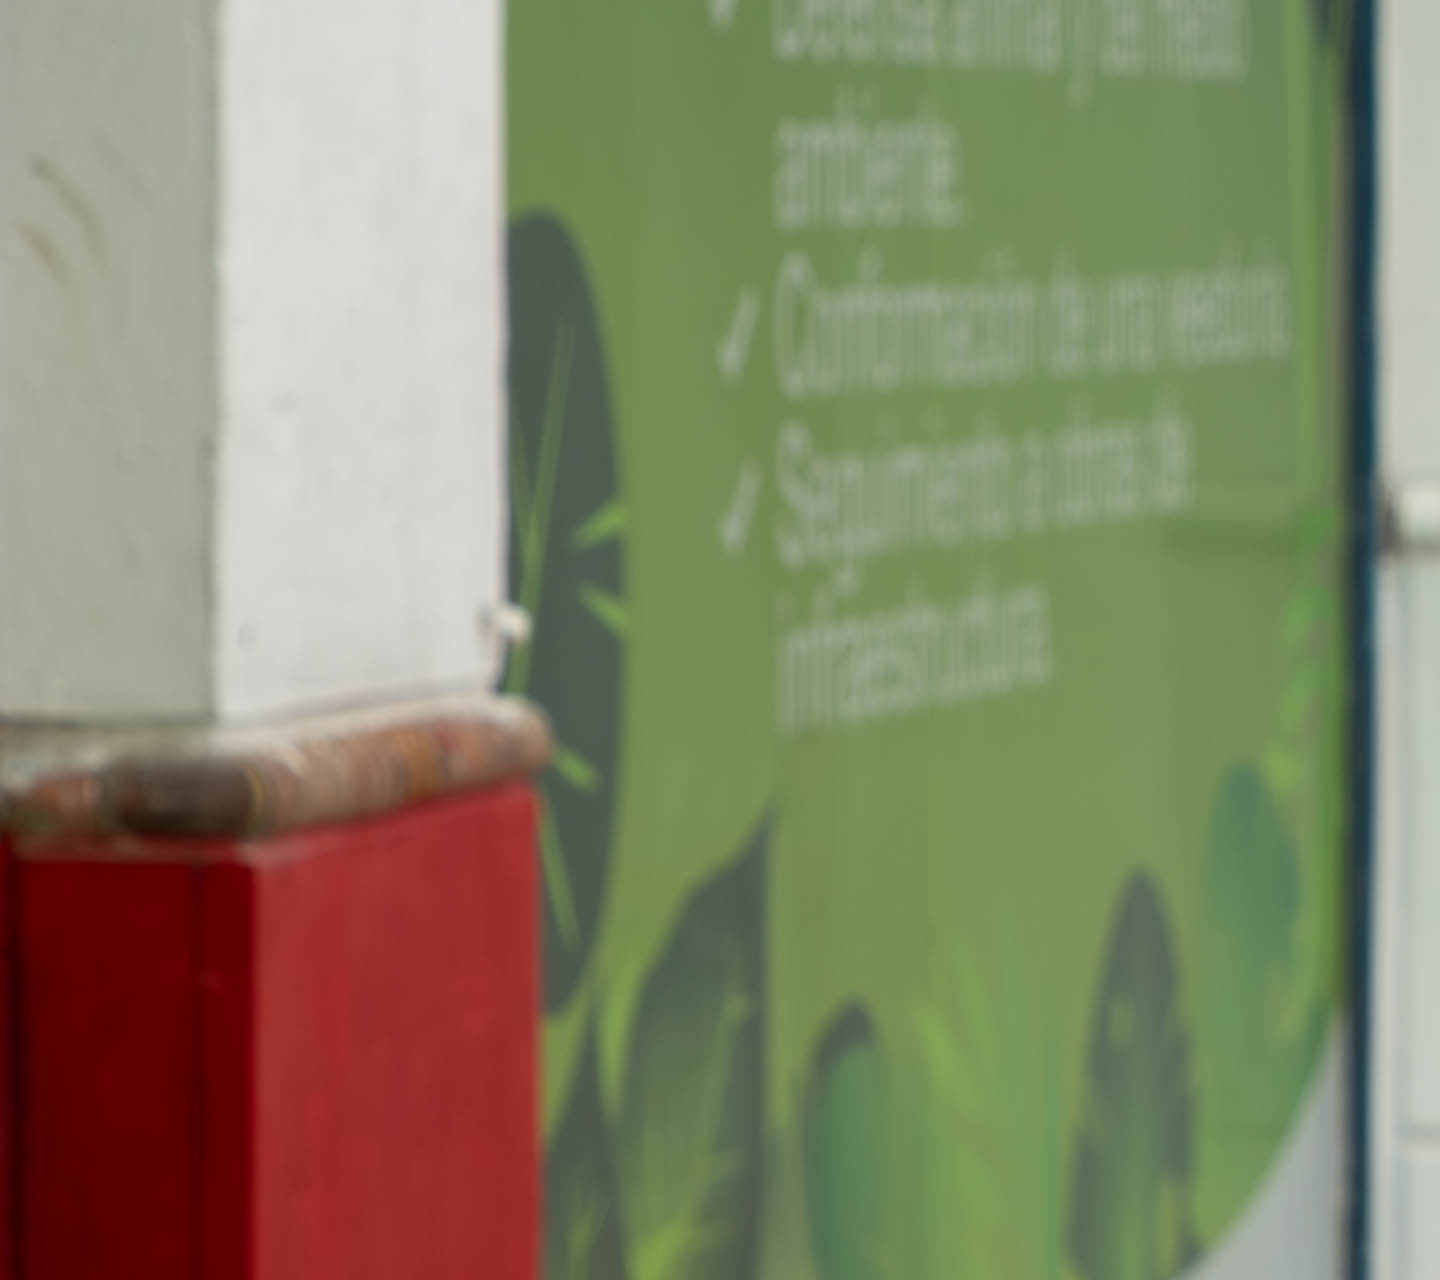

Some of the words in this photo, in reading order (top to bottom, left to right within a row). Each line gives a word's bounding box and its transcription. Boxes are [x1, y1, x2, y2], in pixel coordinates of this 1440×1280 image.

[774, 247, 1036, 401] Conformación
[1050, 242, 1092, 377] de
[775, 417, 1012, 601] Seguimiento
[1152, 380, 1194, 515] de
